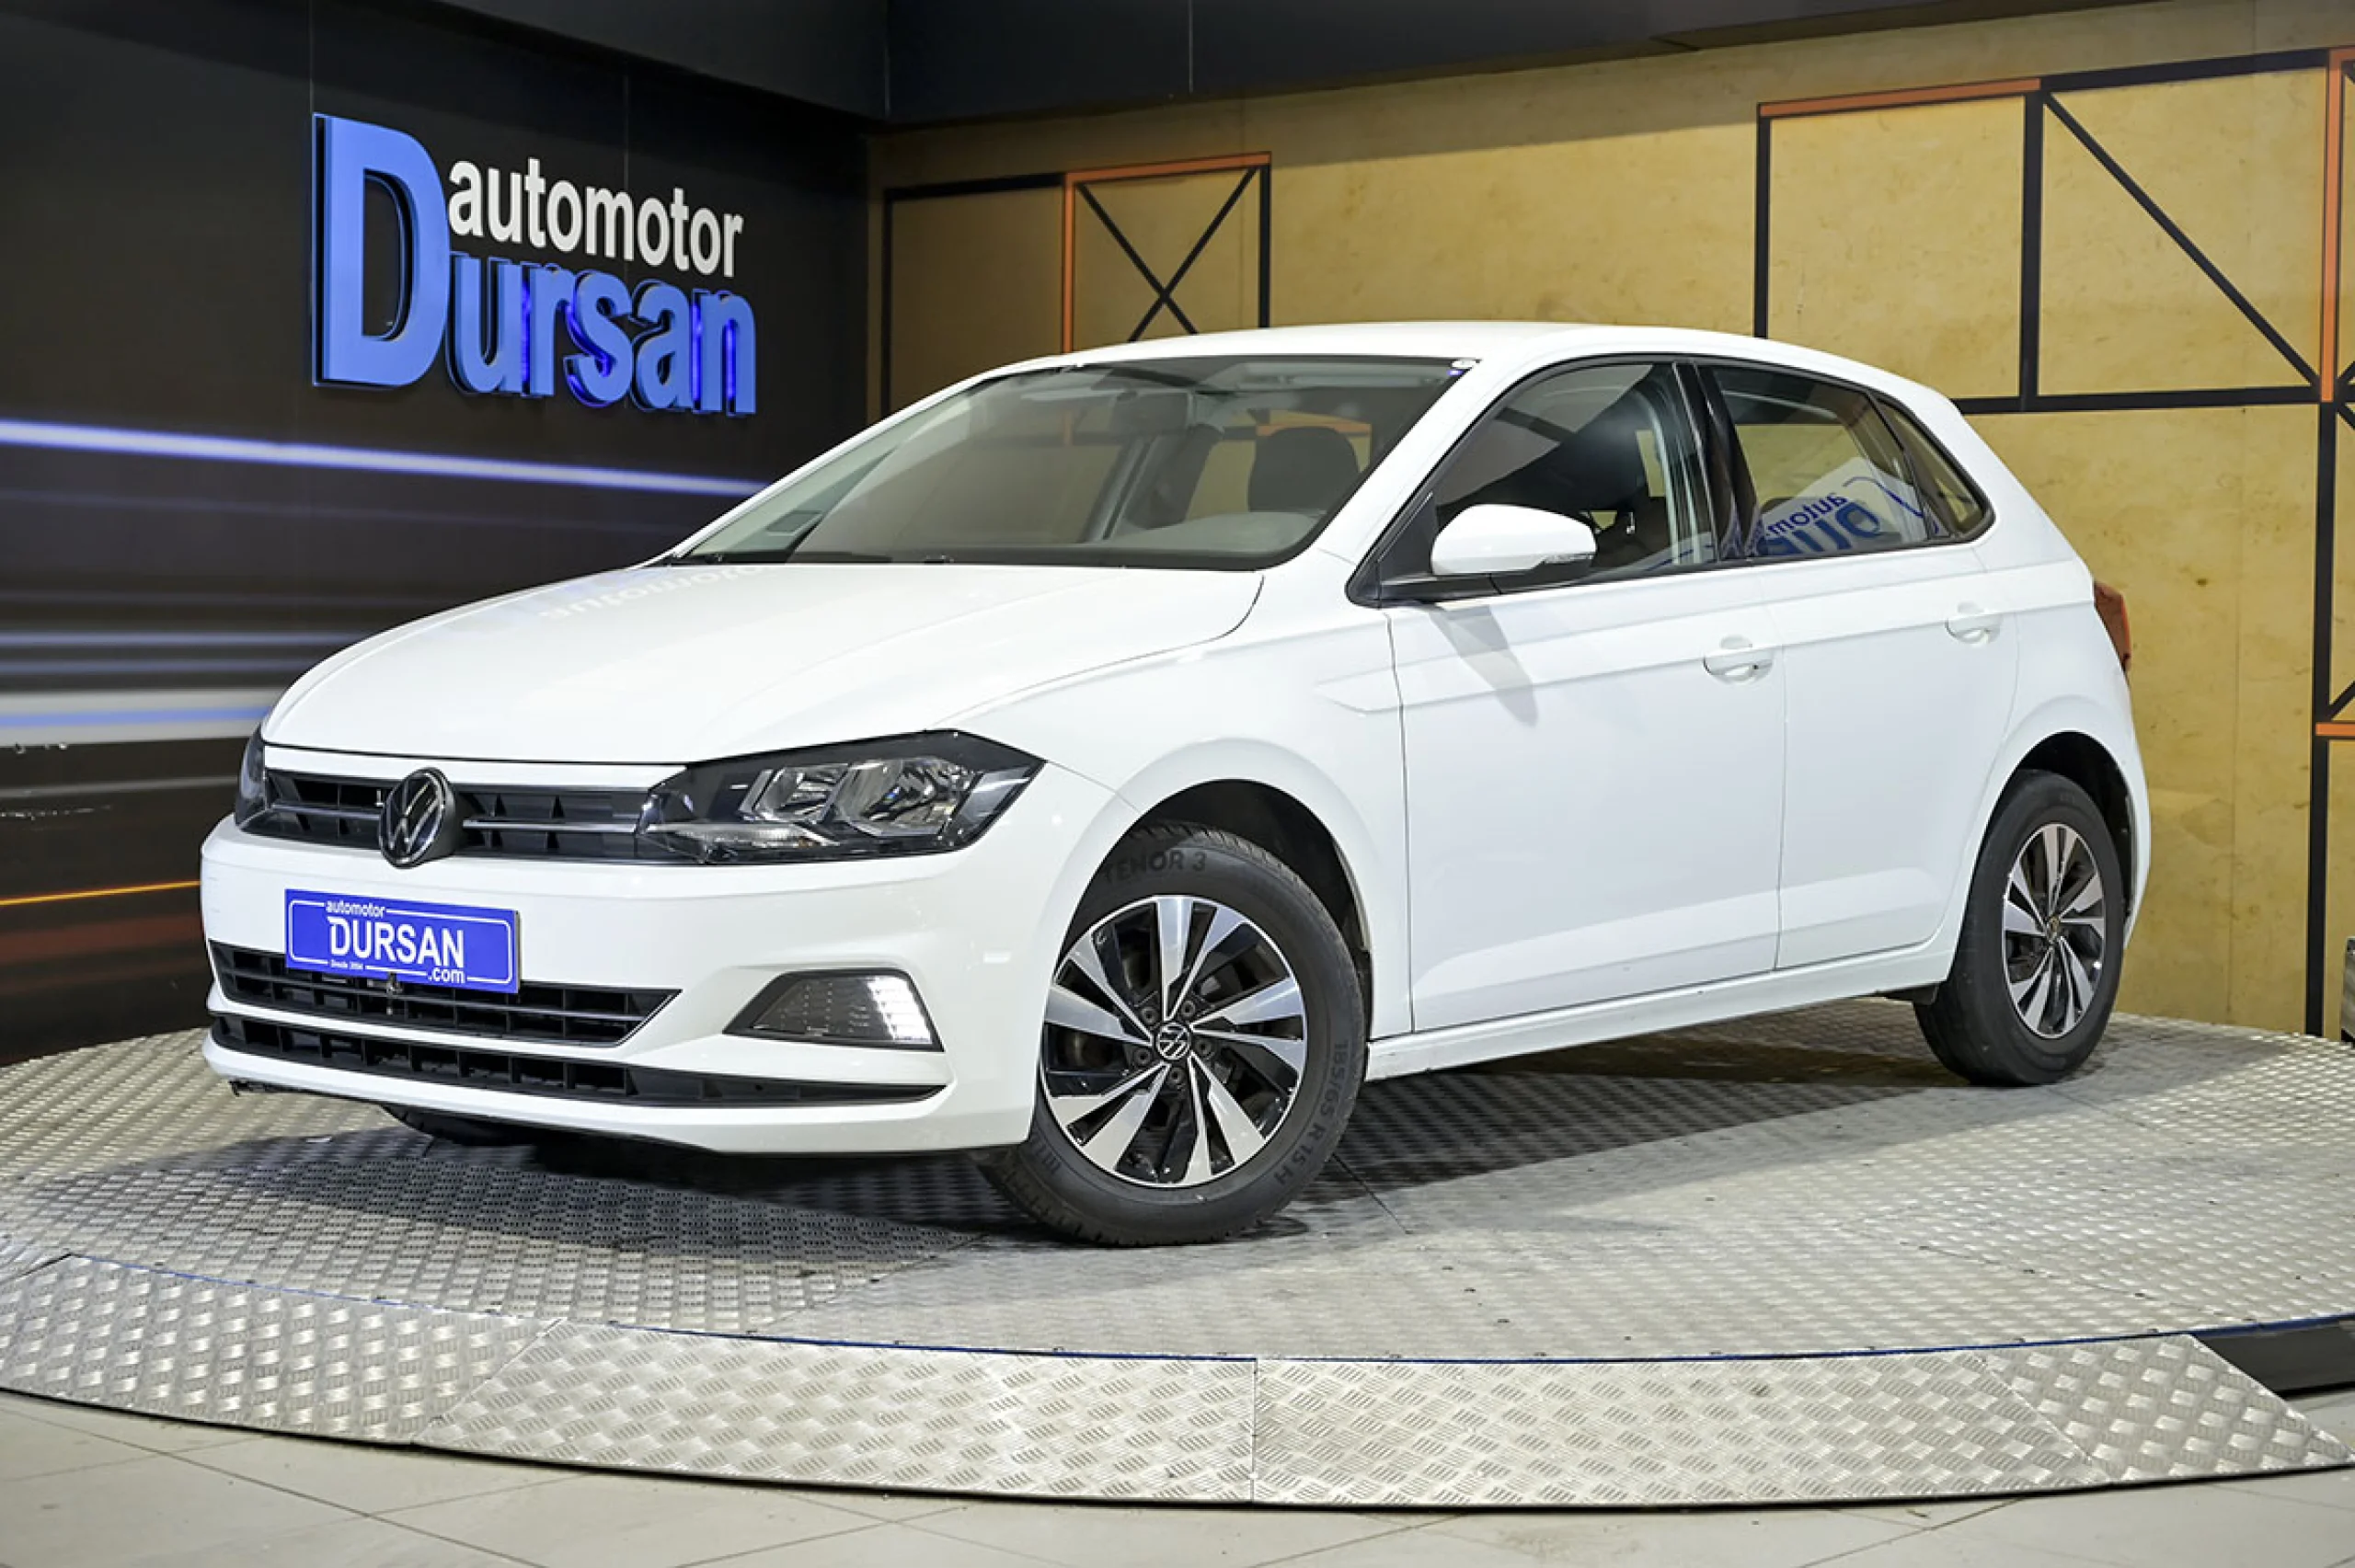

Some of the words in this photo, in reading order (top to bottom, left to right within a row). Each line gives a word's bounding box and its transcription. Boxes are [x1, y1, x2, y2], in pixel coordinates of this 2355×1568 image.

[448, 158, 743, 277] automotor
[313, 113, 757, 415] Dursan
[1193, 852, 1206, 873] 3
[326, 899, 385, 918] automotor
[327, 917, 464, 967] DURSAN
[428, 968, 465, 983] .com
